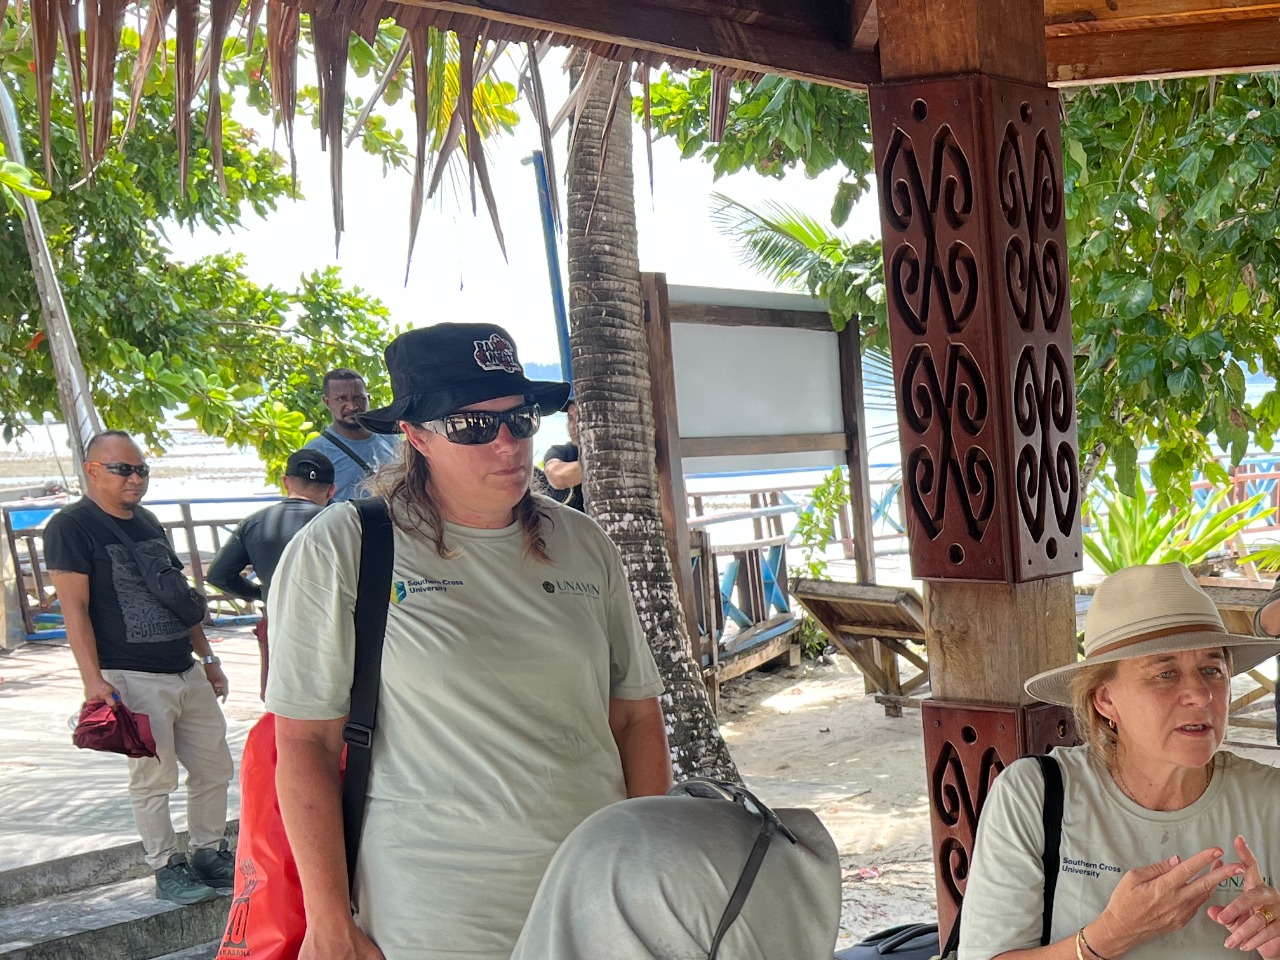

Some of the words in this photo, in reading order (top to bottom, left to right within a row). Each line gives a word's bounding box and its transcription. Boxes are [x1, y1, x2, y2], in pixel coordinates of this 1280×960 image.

[407, 578, 441, 587] Southern
[409, 586, 447, 594] University
[1062, 857, 1097, 869] Southern
[1099, 863, 1121, 873] Cross
[1061, 865, 1100, 878] University
